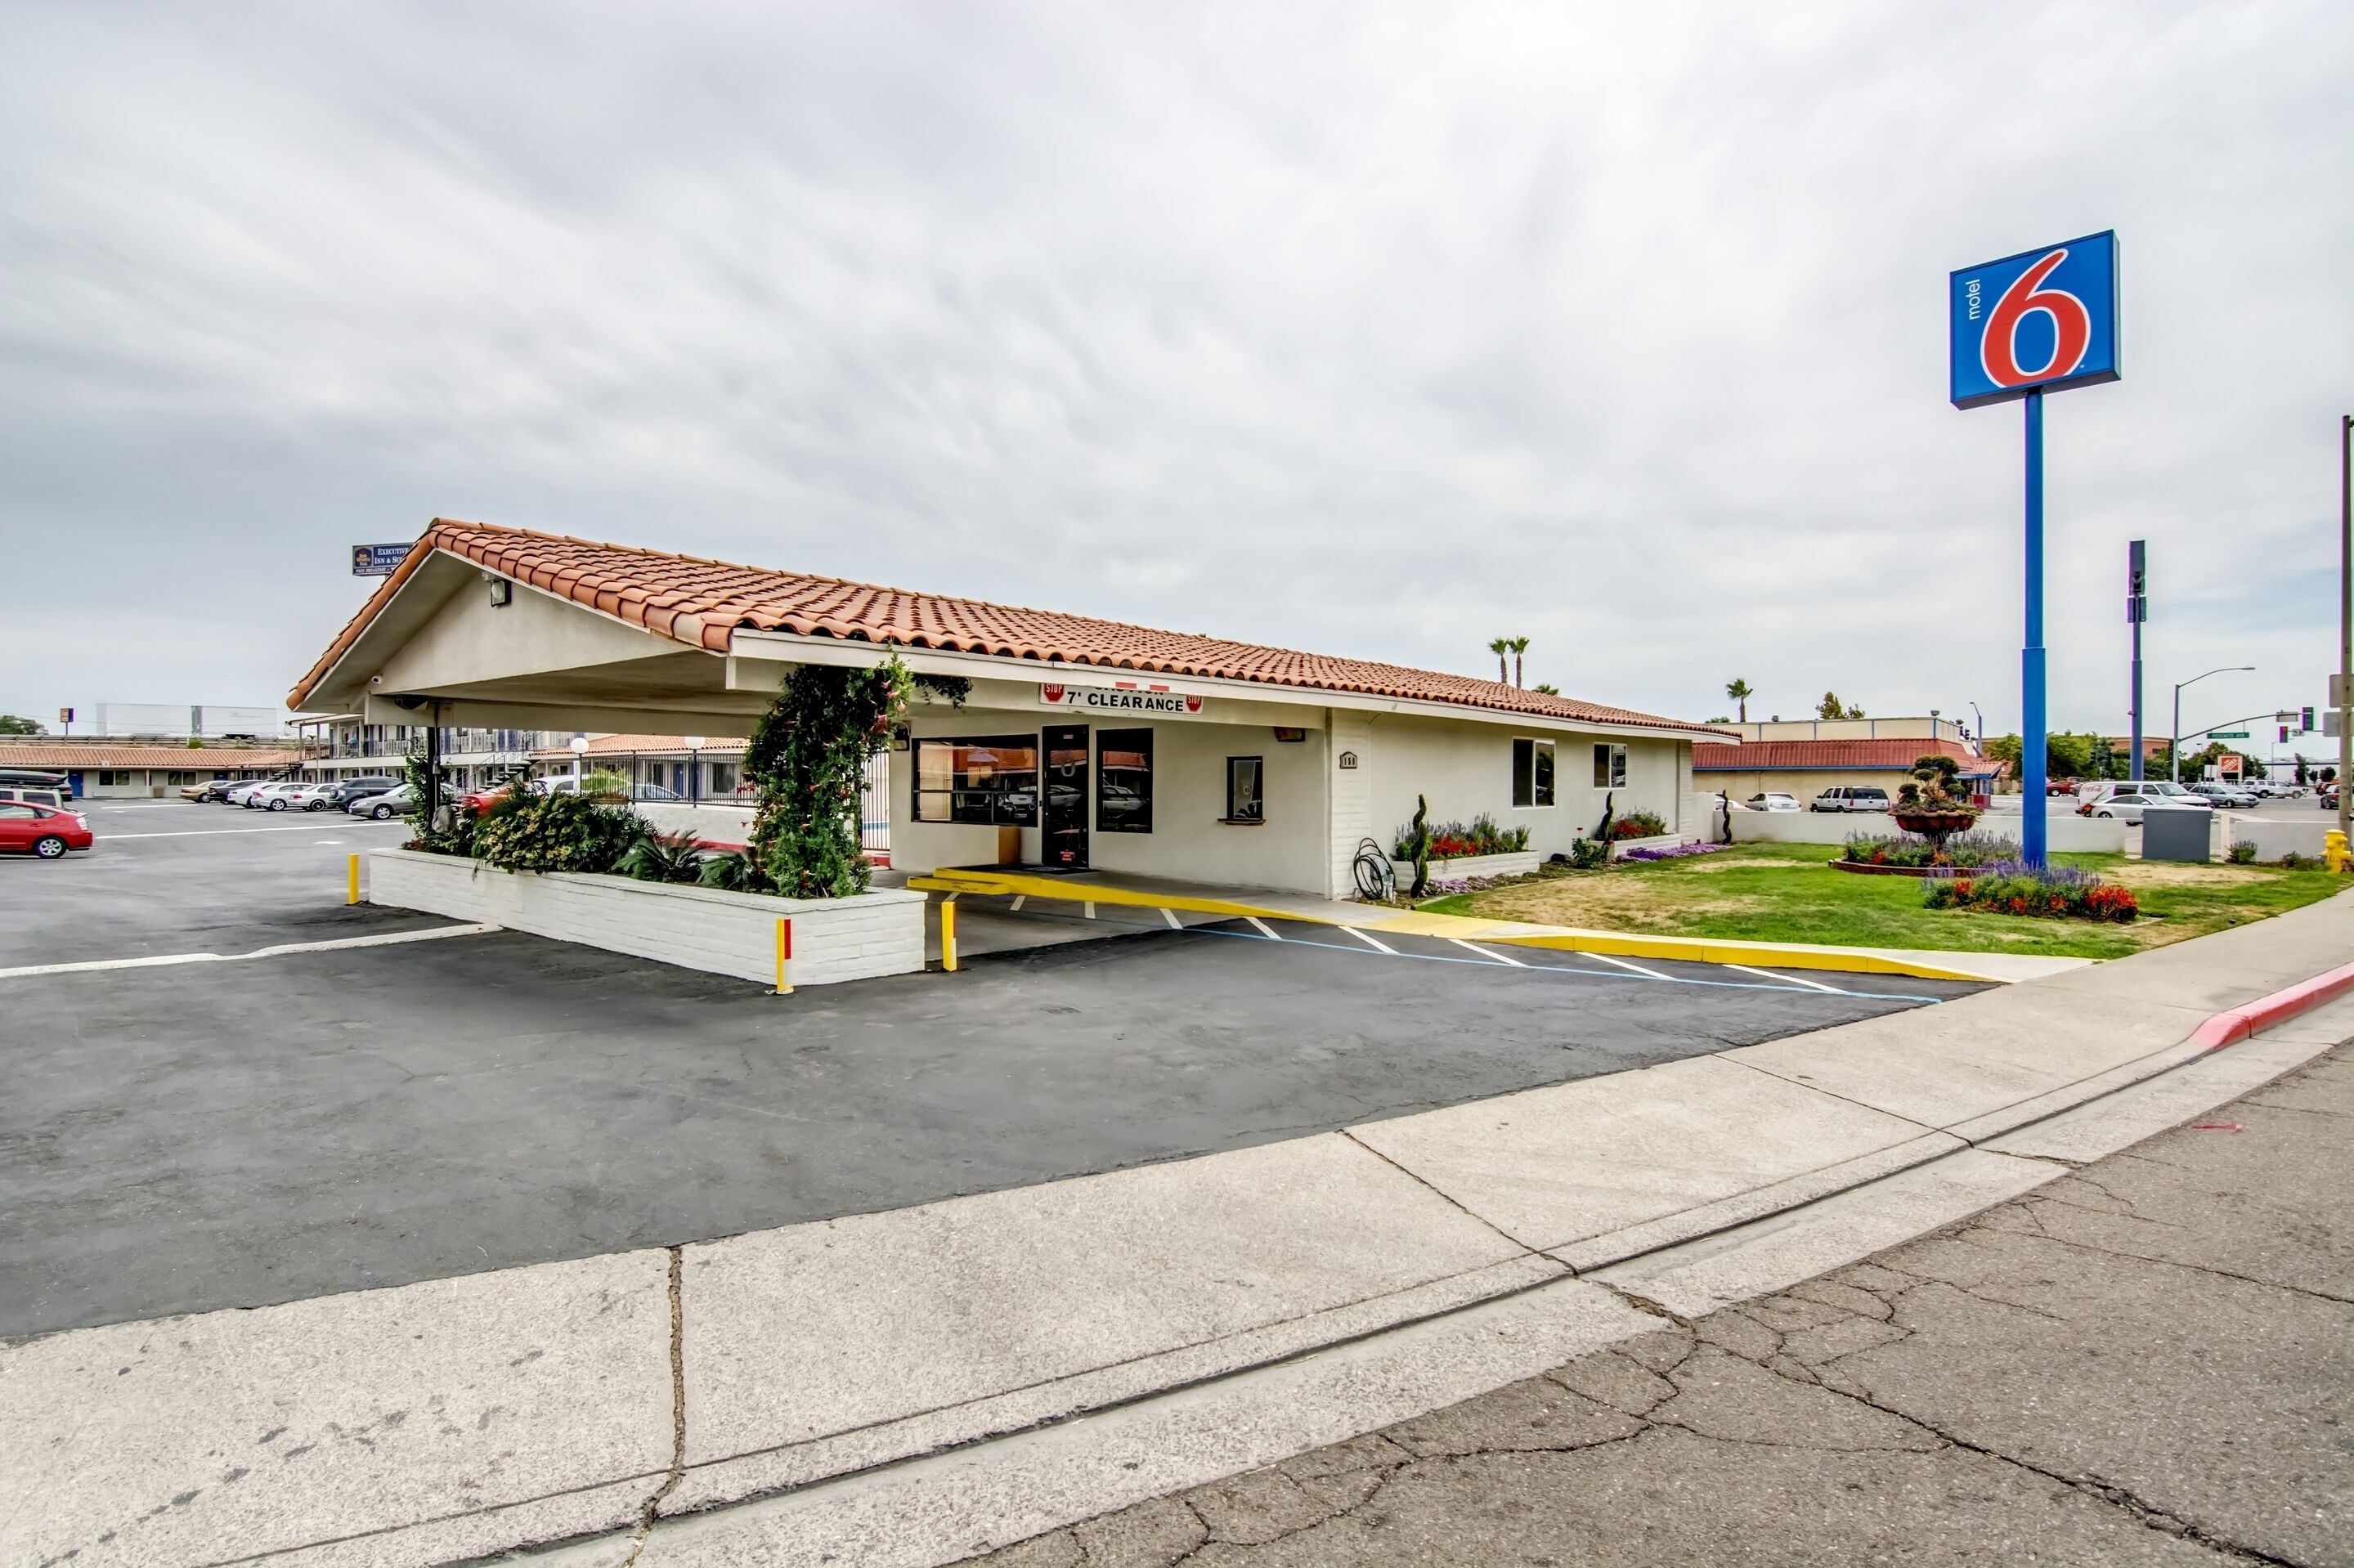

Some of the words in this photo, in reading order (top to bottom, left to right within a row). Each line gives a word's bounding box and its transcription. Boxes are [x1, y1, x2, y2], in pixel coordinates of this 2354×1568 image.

[1965, 279, 1980, 320] motel
[1980, 248, 2091, 388] 6
[1046, 683, 1062, 693] STOP
[1067, 691, 1081, 704] 7'
[1087, 692, 1184, 712] CLEARANCE
[1187, 695, 1202, 705] STOP
